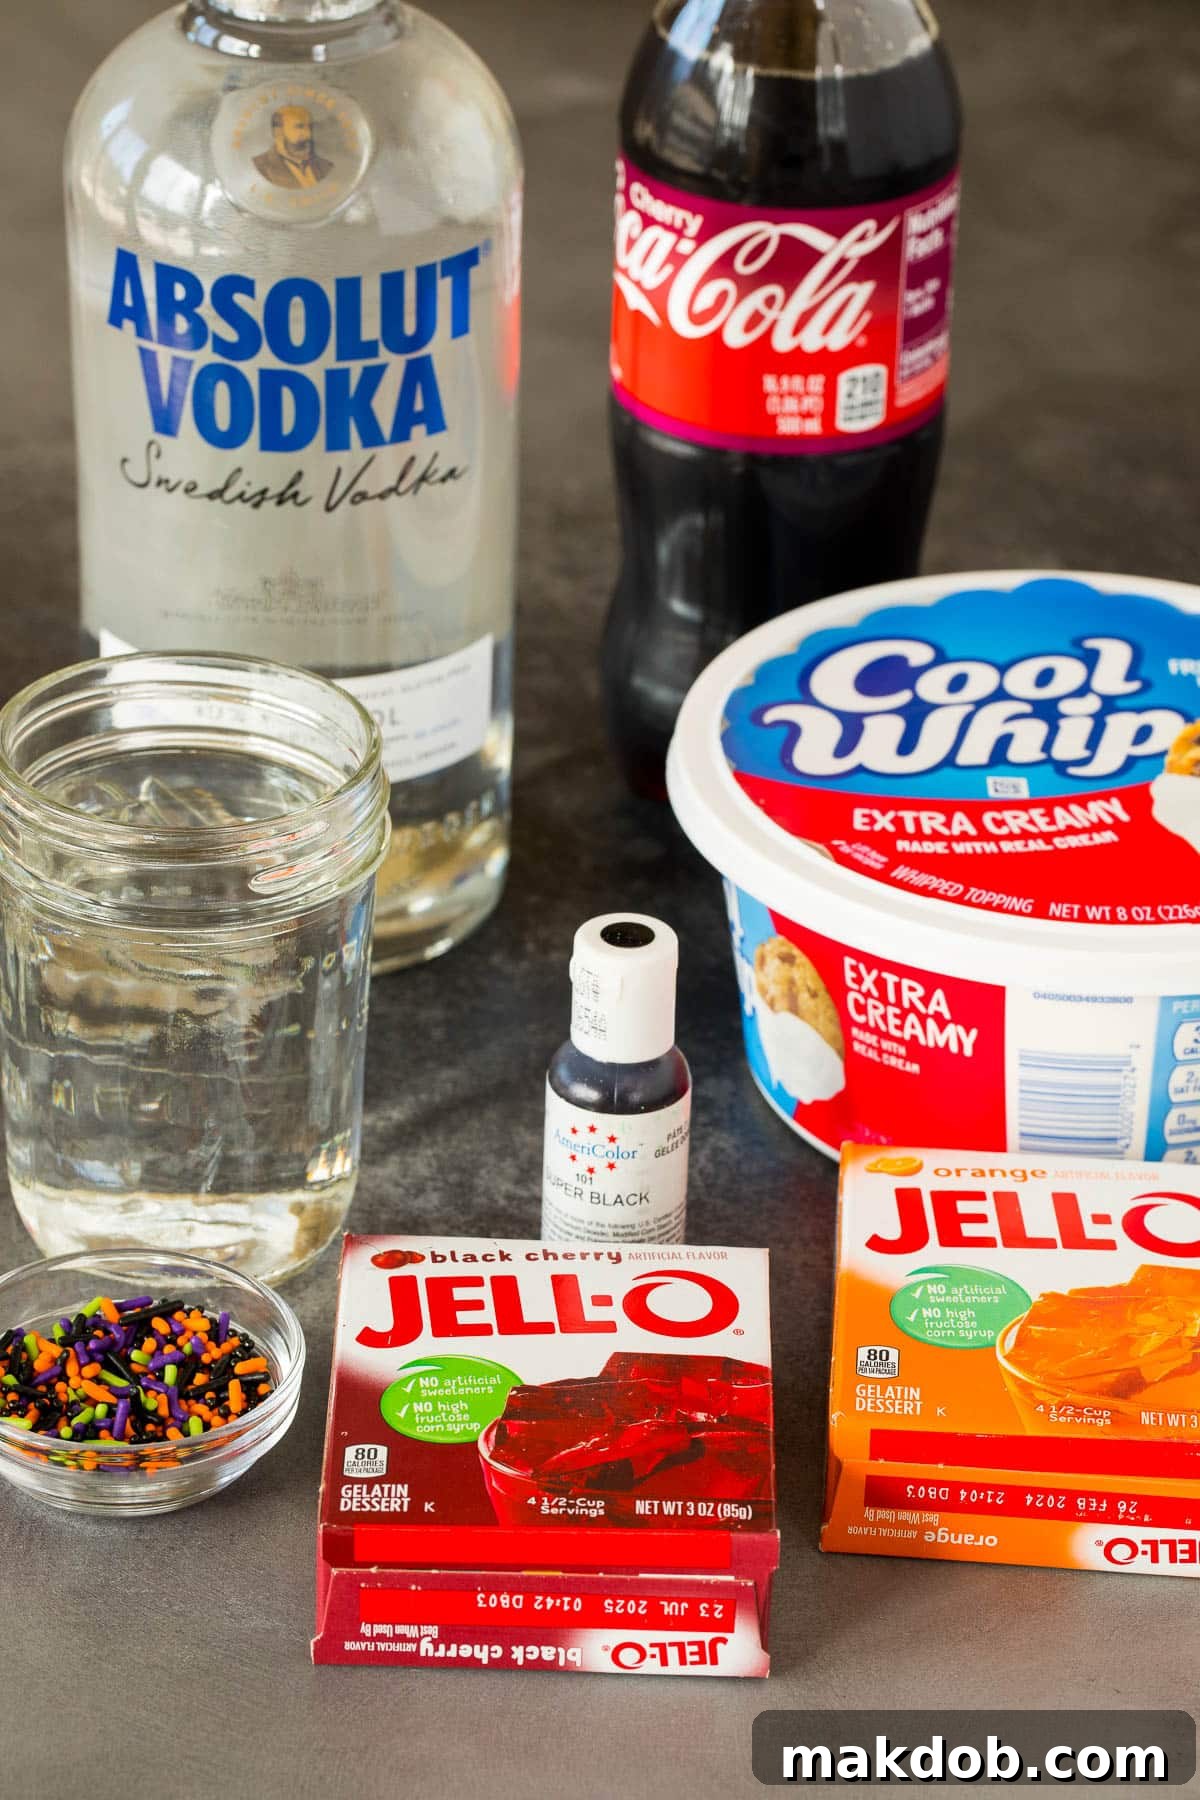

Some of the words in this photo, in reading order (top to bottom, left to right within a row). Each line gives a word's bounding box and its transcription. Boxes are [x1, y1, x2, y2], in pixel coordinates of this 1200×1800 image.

[629, 182, 704, 237] Cherry
[615, 208, 902, 354] ca-Cola
[107, 246, 480, 364] ABSOLUT
[138, 353, 447, 453] VODKA
[120, 440, 311, 510] Swedish
[324, 452, 468, 513] Vodka
[809, 637, 1142, 713] Cool
[763, 692, 1186, 778] Whip
[853, 807, 977, 837] EXTRA
[982, 797, 1131, 836] CREAMY
[896, 840, 949, 854] MADE
[951, 841, 998, 855] WITH
[1000, 838, 1054, 854] REAL
[1053, 830, 1119, 851] CREAM
[890, 864, 964, 897] WHIPPED
[964, 887, 1034, 914] TOPPING
[1048, 902, 1081, 919] NET
[1085, 905, 1111, 921] WT
[1116, 906, 1128, 922] 8
[1131, 906, 1155, 921] OZ
[843, 955, 951, 1021] EXTRA
[846, 991, 978, 1058] CREAMY
[851, 1026, 879, 1049] MADE
[880, 1037, 907, 1057] WITH
[853, 1041, 881, 1065] REAL
[881, 1051, 921, 1075] CREAM
[553, 1127, 638, 1161] AmeriColor
[576, 1172, 593, 1185] 101
[934, 1166, 1048, 1182] orange
[590, 1190, 650, 1207] BLACK
[865, 1187, 1200, 1258] JELL-O
[431, 1249, 513, 1265] black
[526, 1249, 622, 1266] cherry
[628, 1251, 683, 1261] ARTIFICIAL
[685, 1251, 729, 1261] FLAVOR
[927, 1284, 946, 1295] NO
[950, 1284, 1008, 1297] artificial
[929, 1293, 1000, 1305] sweeteners
[355, 1269, 740, 1349] JELL-O
[922, 1308, 941, 1319] NO
[946, 1307, 976, 1321] high
[924, 1317, 978, 1330] fructose
[926, 1329, 955, 1339] corn
[958, 1327, 995, 1341] syrup
[866, 1348, 890, 1362] 80
[858, 1360, 897, 1370] CALORIES
[419, 1376, 439, 1388] NO
[444, 1374, 503, 1387] artificial
[420, 1384, 494, 1397] sweeteners
[855, 1383, 921, 1401] GELATIN
[413, 1402, 433, 1413] NO
[438, 1400, 469, 1414] high
[855, 1397, 923, 1416] DESSERT
[937, 1407, 947, 1416] K
[1036, 1405, 1044, 1413] 4
[1051, 1404, 1111, 1418] 1/2-Cup
[415, 1410, 471, 1424] fructose
[1049, 1413, 1111, 1426] Servings
[1141, 1412, 1165, 1426] NET
[1167, 1414, 1187, 1428] WT
[1191, 1415, 1199, 1428] 3
[416, 1424, 446, 1434] corn
[446, 1421, 481, 1435] syrup
[354, 1447, 378, 1462] 80
[346, 1459, 385, 1469] CALORIES
[341, 1484, 408, 1498] GELATIN
[906, 1484, 949, 1500] DB03
[959, 1489, 1005, 1504] 21:04
[339, 1498, 410, 1513] DESSERT
[424, 1502, 435, 1512] K
[527, 1497, 536, 1506] 4
[548, 1496, 605, 1510] 1/2-Cup
[1025, 1494, 1066, 1509] 2024
[1077, 1497, 1107, 1512] FEB
[540, 1504, 605, 1517] Servings
[635, 1500, 659, 1514] NET
[662, 1501, 684, 1516] WT
[687, 1501, 695, 1516] 3
[697, 1501, 714, 1517] OZ
[717, 1502, 752, 1520] (85g)
[864, 1507, 875, 1520] By
[876, 1509, 896, 1521] Used
[898, 1511, 921, 1525] When
[922, 1513, 939, 1525] Best
[847, 1526, 876, 1537] FLAVOR
[878, 1528, 917, 1538] ARTIFICIAL
[924, 1530, 998, 1547] orange
[1103, 1537, 1200, 1566] ELL-O
[477, 1592, 524, 1609] DB03
[533, 1596, 582, 1612] 01:42
[604, 1599, 648, 1615] 2025
[662, 1600, 688, 1617] JUL
[699, 1601, 724, 1618] 23
[360, 1622, 372, 1636] By
[373, 1623, 394, 1637] Used
[395, 1624, 417, 1638] When
[418, 1625, 438, 1638] Best
[344, 1640, 375, 1651] FLAVOR
[377, 1641, 417, 1653] ARTIFICIAL
[420, 1638, 502, 1662] cherry
[611, 1636, 729, 1669] JELL-O
[511, 1645, 582, 1664] black
